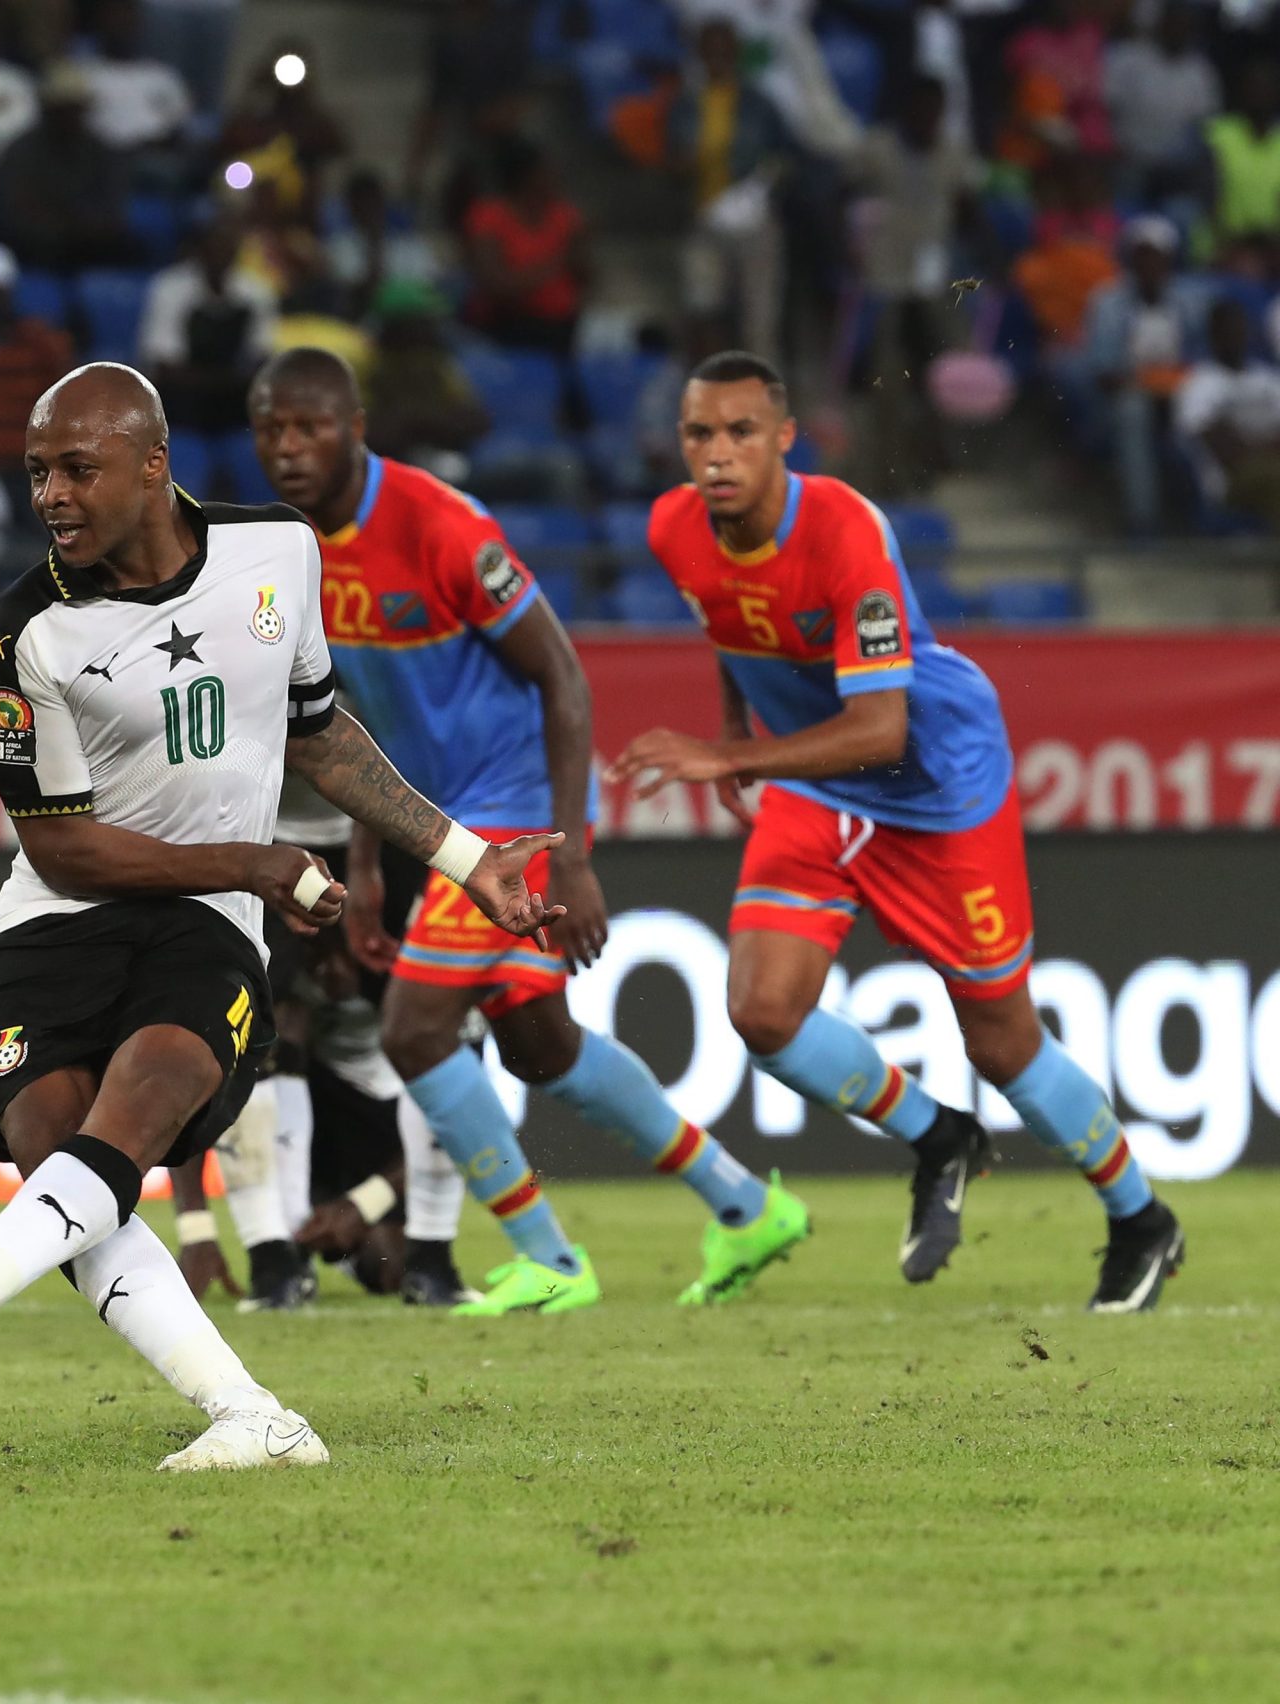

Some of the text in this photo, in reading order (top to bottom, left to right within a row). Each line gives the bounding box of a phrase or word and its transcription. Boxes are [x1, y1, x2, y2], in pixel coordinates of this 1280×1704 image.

[322, 579, 381, 634] 22
[739, 596, 779, 648] 5
[160, 675, 225, 765] 10
[1018, 738, 1280, 831] 2017
[962, 886, 1006, 944] 5
[564, 908, 1280, 1180] Orang
